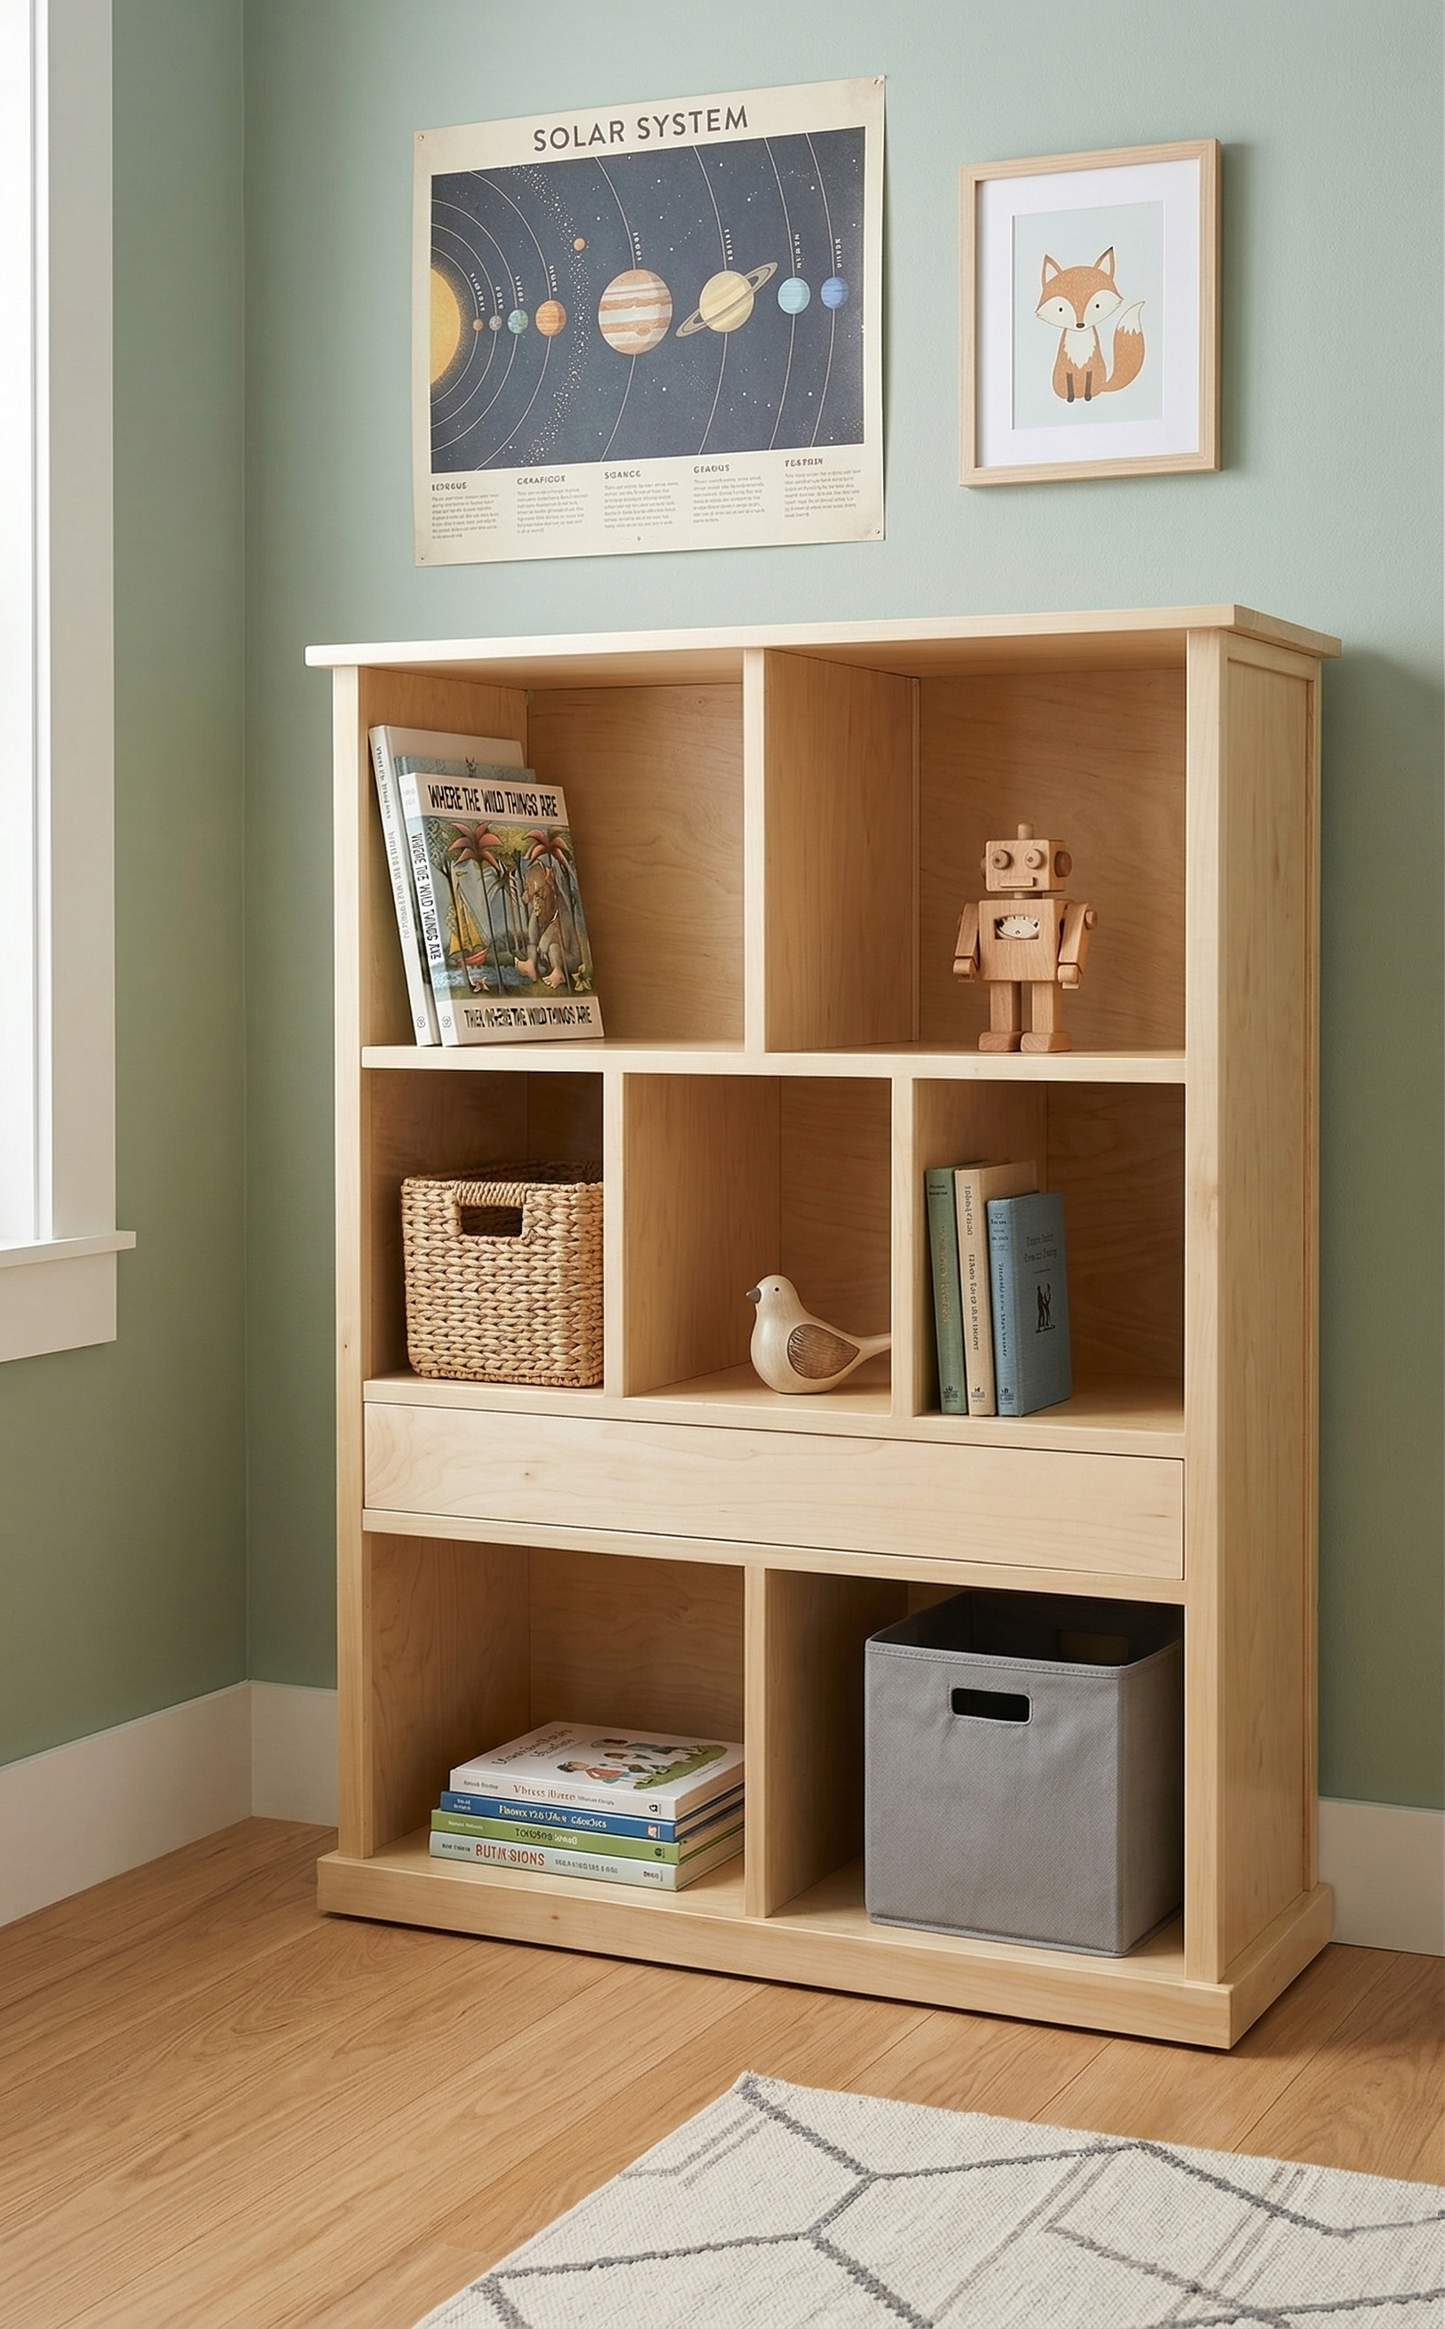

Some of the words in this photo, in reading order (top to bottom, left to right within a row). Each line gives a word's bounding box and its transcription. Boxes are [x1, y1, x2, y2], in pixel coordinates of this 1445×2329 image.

[533, 120, 625, 152] SOLAR
[636, 105, 748, 140] SYSTEM
[427, 785, 463, 811] WHERE
[462, 787, 482, 812] THE
[481, 789, 505, 814] WILD
[505, 791, 539, 817] THINGS
[539, 794, 559, 817] ARE
